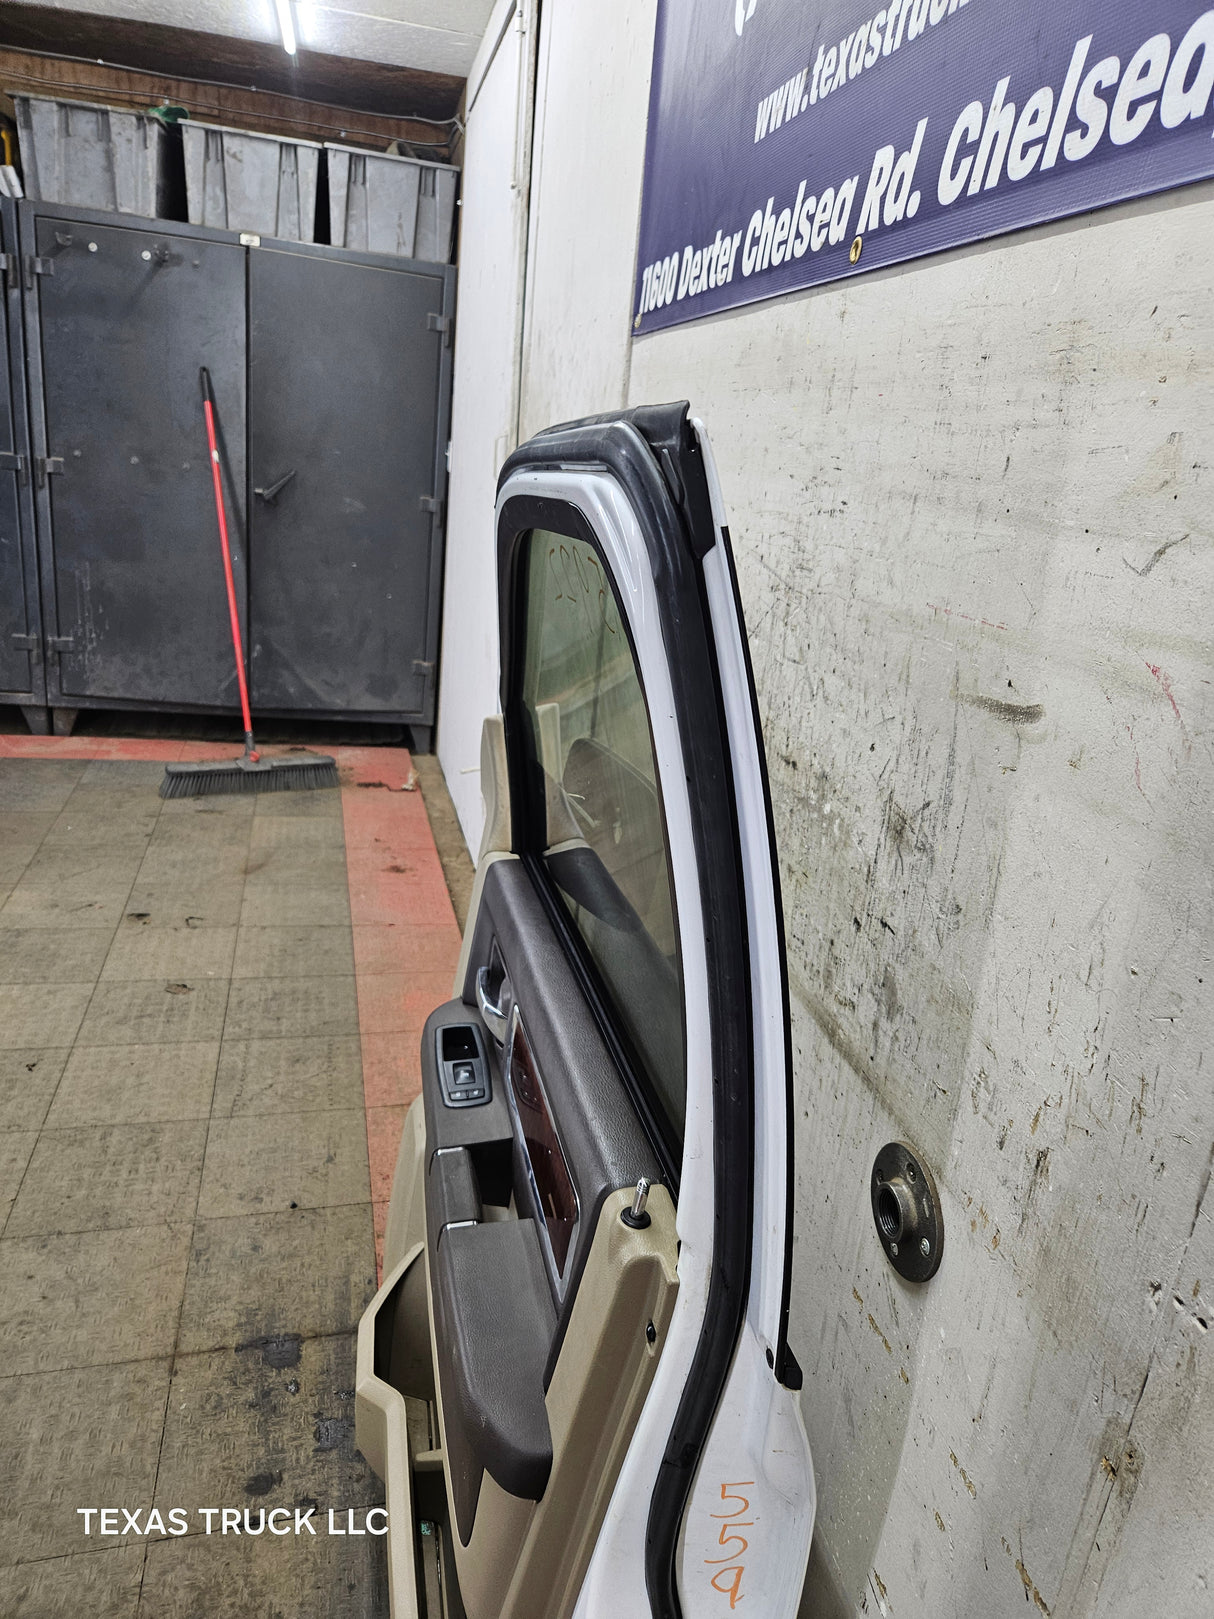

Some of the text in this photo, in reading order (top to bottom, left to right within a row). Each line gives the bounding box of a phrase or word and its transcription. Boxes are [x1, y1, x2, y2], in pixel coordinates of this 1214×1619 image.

[638, 251, 680, 315] 11600
[676, 229, 742, 301] Dexter
[741, 175, 860, 277] Chelsea
[855, 117, 929, 236] Rd.
